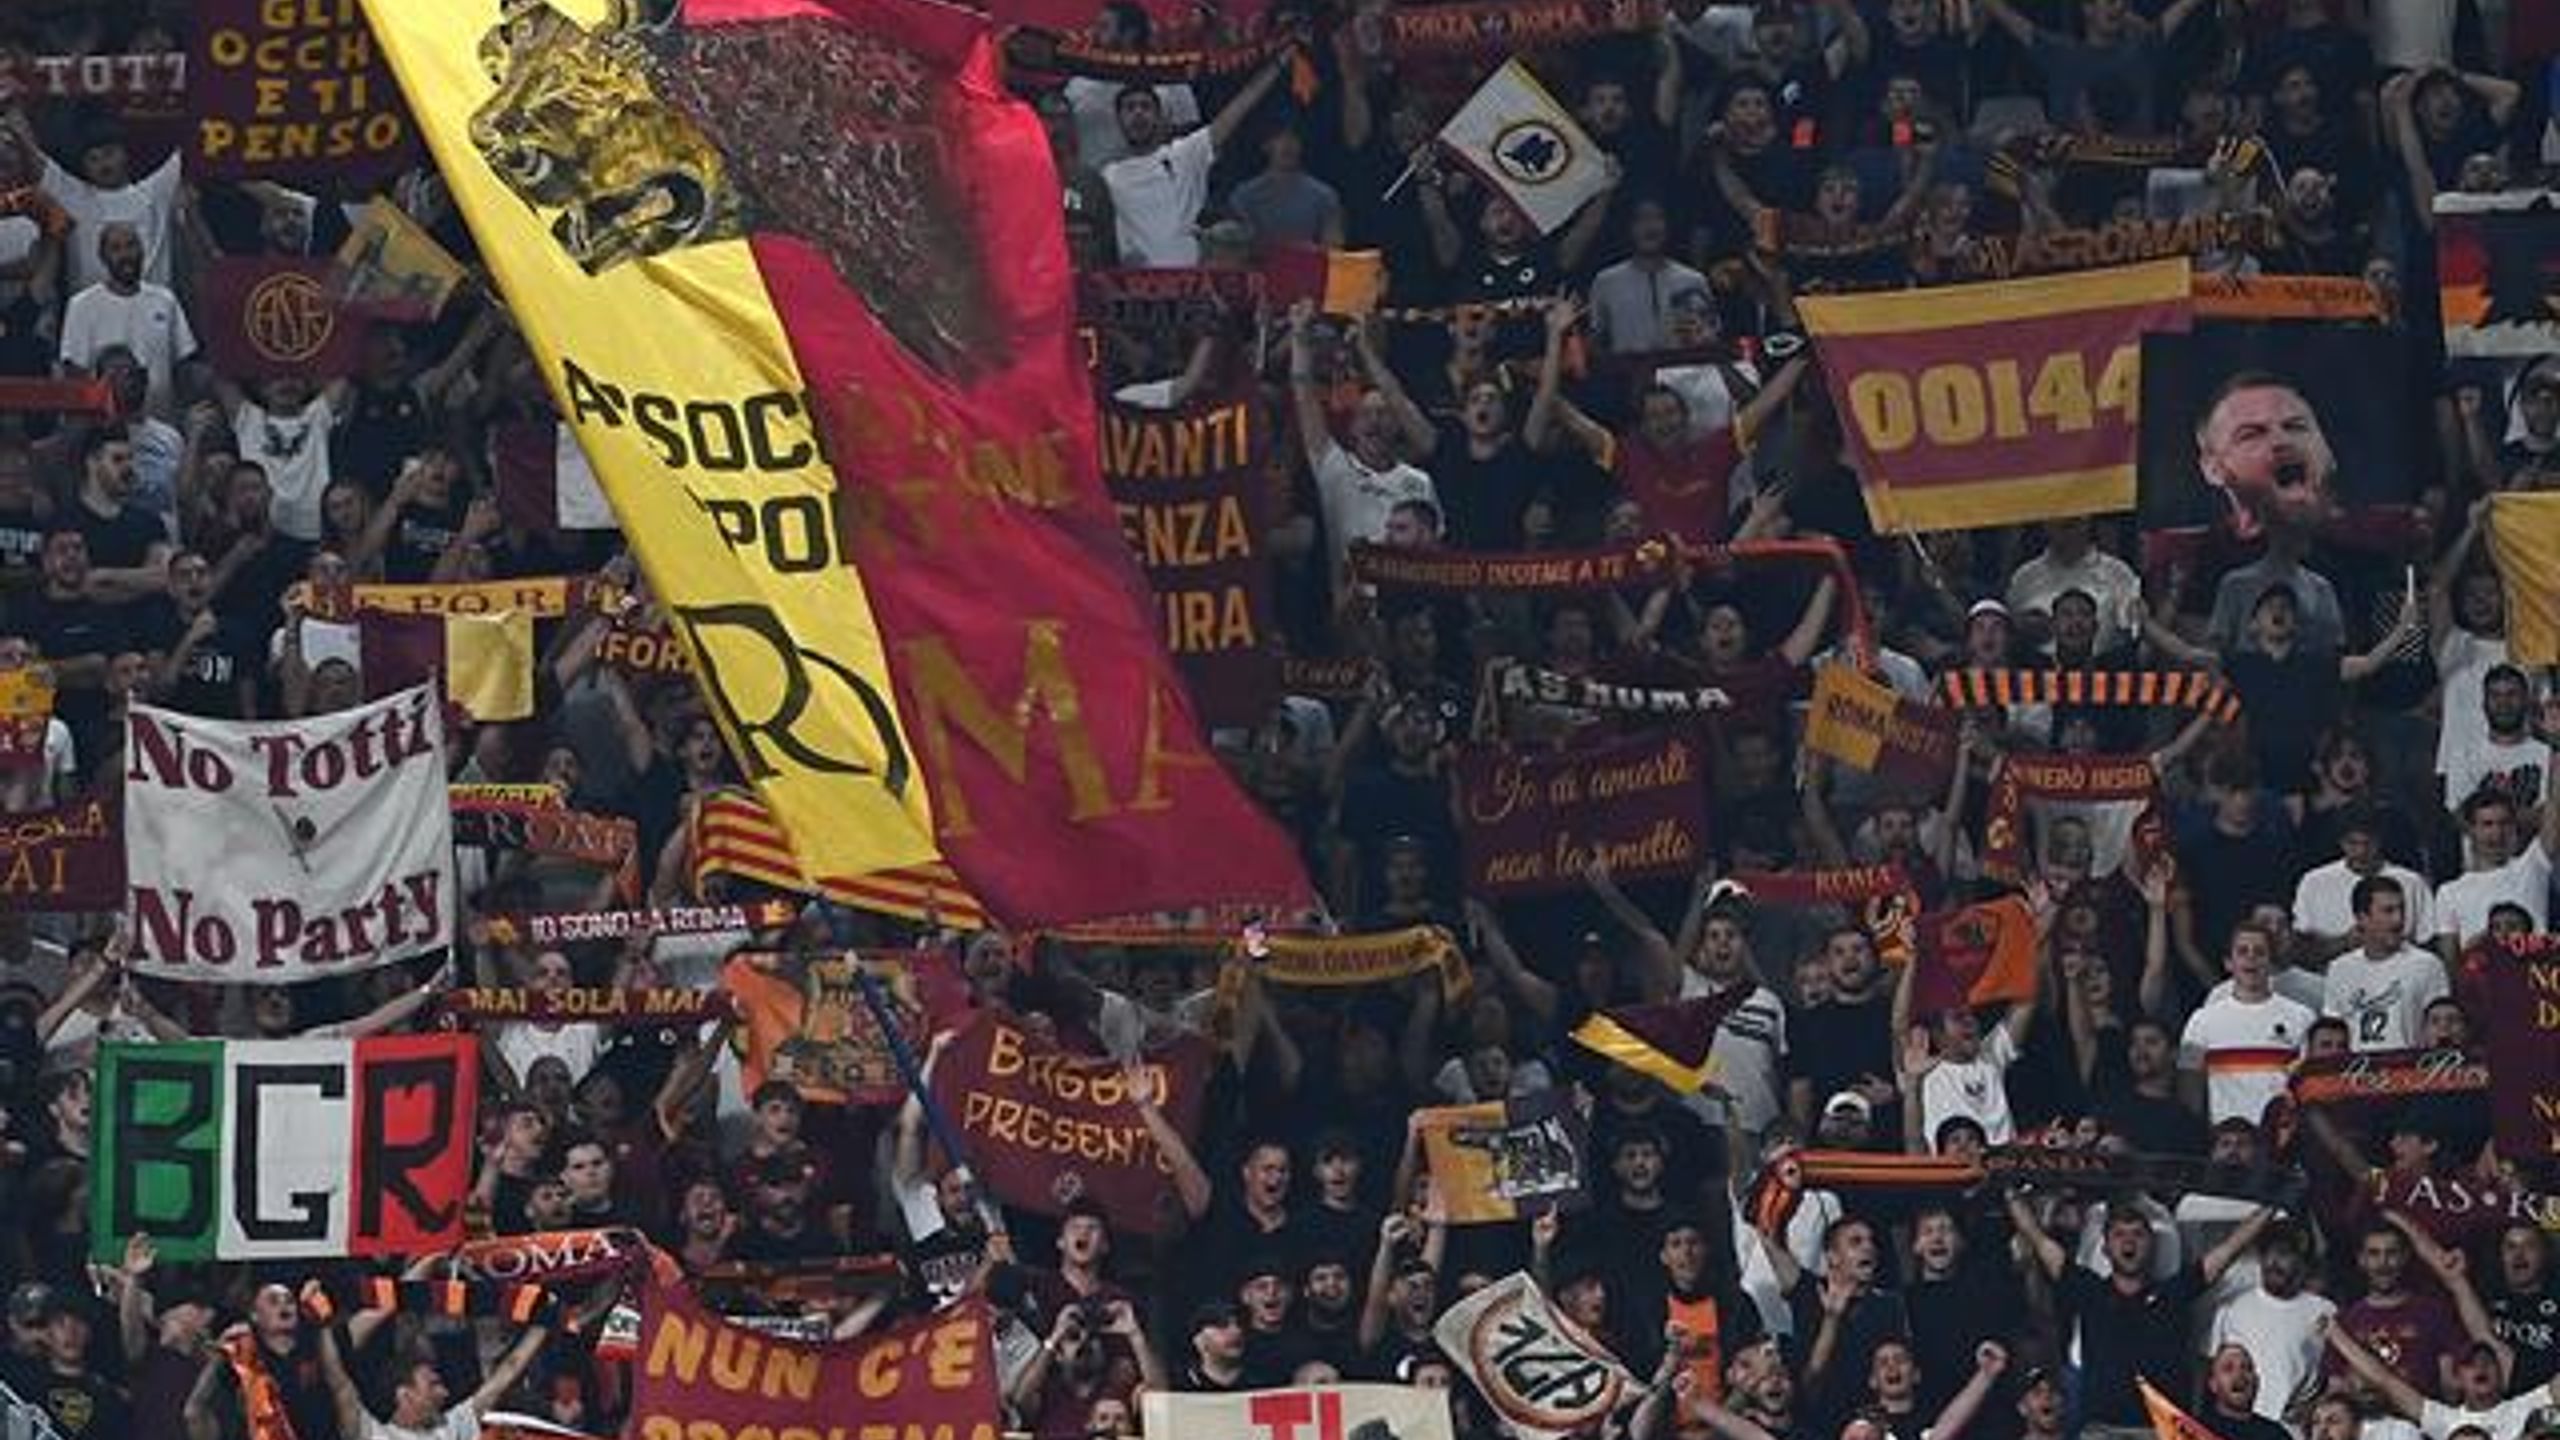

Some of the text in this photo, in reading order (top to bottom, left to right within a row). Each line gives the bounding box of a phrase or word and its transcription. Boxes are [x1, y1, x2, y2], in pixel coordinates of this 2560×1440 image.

[262, 0, 354, 29] GLI
[256, 74, 367, 115] E TI
[201, 112, 399, 162] PENSO
[1848, 351, 2140, 452] 00144
[127, 689, 433, 798] No Totti
[126, 869, 441, 968] No Party
[560, 911, 631, 941] SONO
[671, 904, 747, 934] ROMA
[470, 987, 528, 1016] MAI
[546, 985, 630, 1016] SOLA
[112, 1057, 459, 1241] BGR
[648, 1312, 820, 1399] NUN
